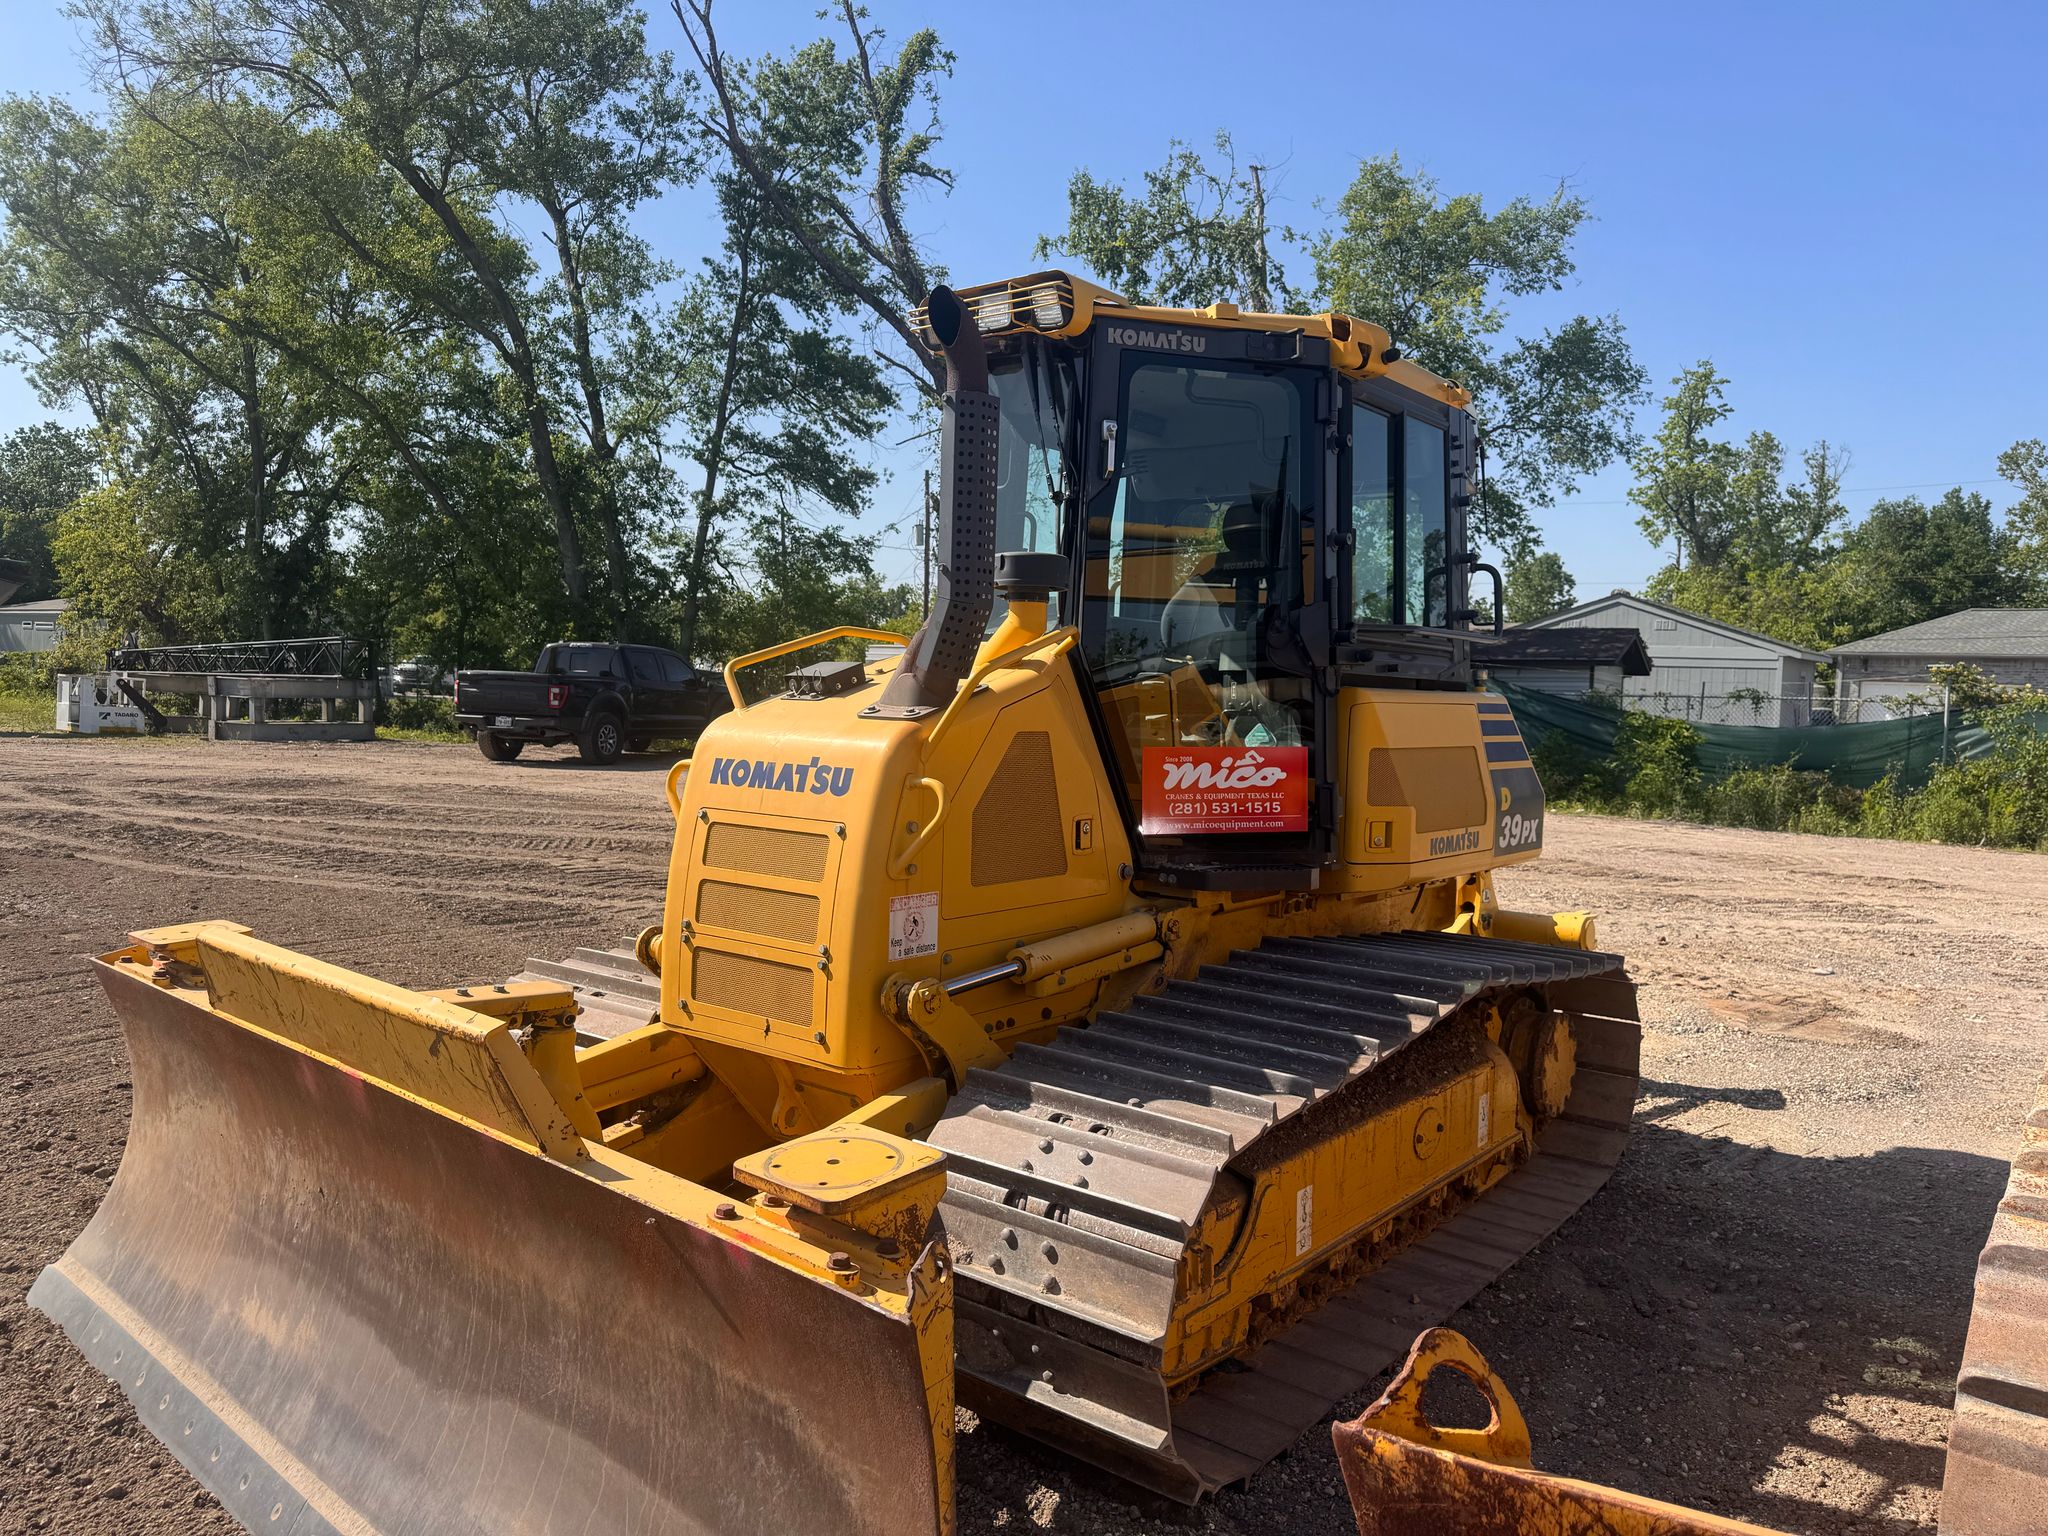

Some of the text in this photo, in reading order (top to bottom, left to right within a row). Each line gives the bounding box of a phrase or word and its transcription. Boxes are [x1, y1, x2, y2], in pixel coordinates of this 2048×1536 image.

[1107, 328, 1206, 353] KOMATSU
[709, 756, 855, 797] KOMATSU
[1204, 792, 1245, 800] EQUIPMENT
[1500, 787, 1512, 811] D
[1169, 801, 1281, 816] (281) 531-1515
[1166, 820, 1284, 830] www.micoequipment.com
[1499, 813, 1539, 848] 39PX
[1430, 829, 1479, 856] KOMATSU
[890, 938, 902, 948] Keep
[904, 945, 914, 956] safe
[916, 943, 936, 954] distance
